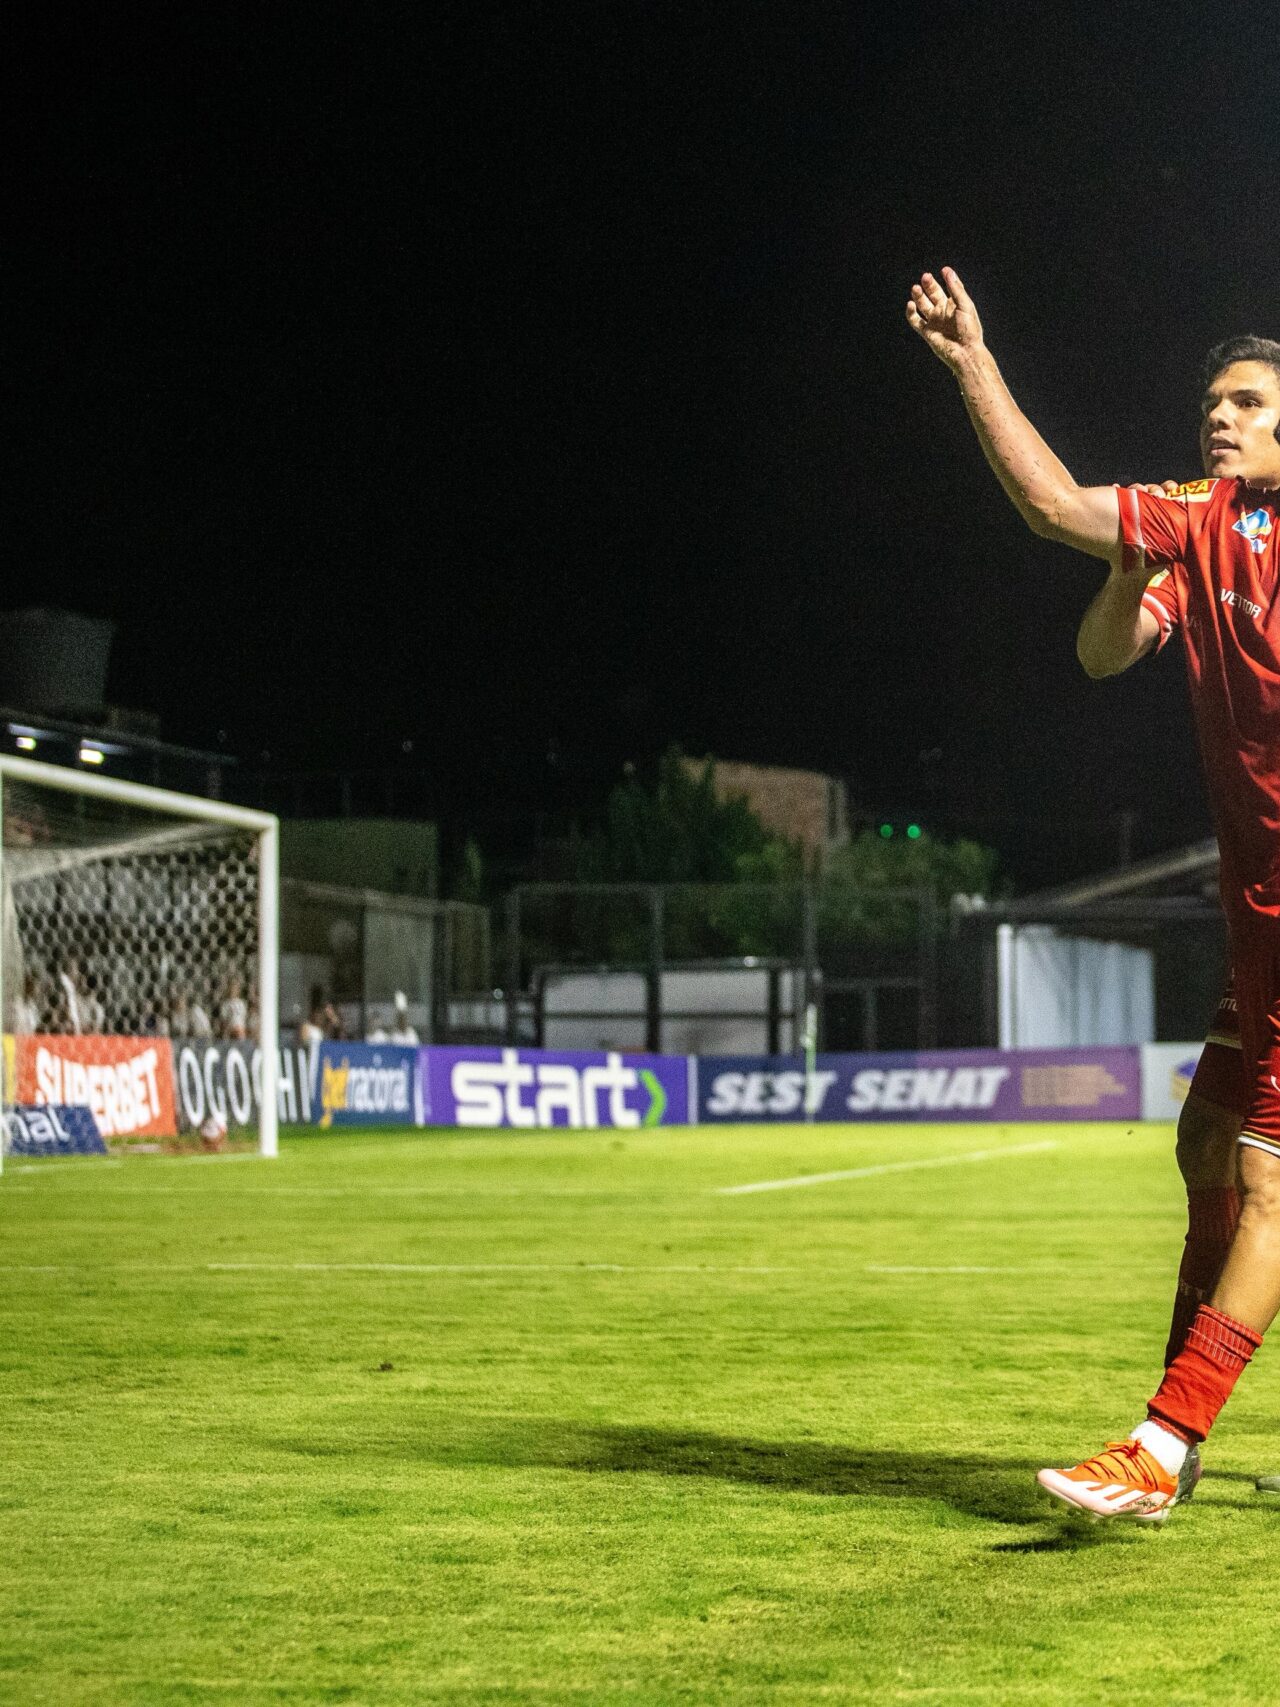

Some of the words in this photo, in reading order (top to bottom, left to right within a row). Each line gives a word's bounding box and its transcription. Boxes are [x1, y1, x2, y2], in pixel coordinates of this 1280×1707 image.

[1220, 588, 1262, 619] VETTOR
[35, 1046, 161, 1136] SUPERBET
[451, 1048, 641, 1128] start
[706, 1071, 837, 1115] SEST
[847, 1067, 1010, 1112] SENAT
